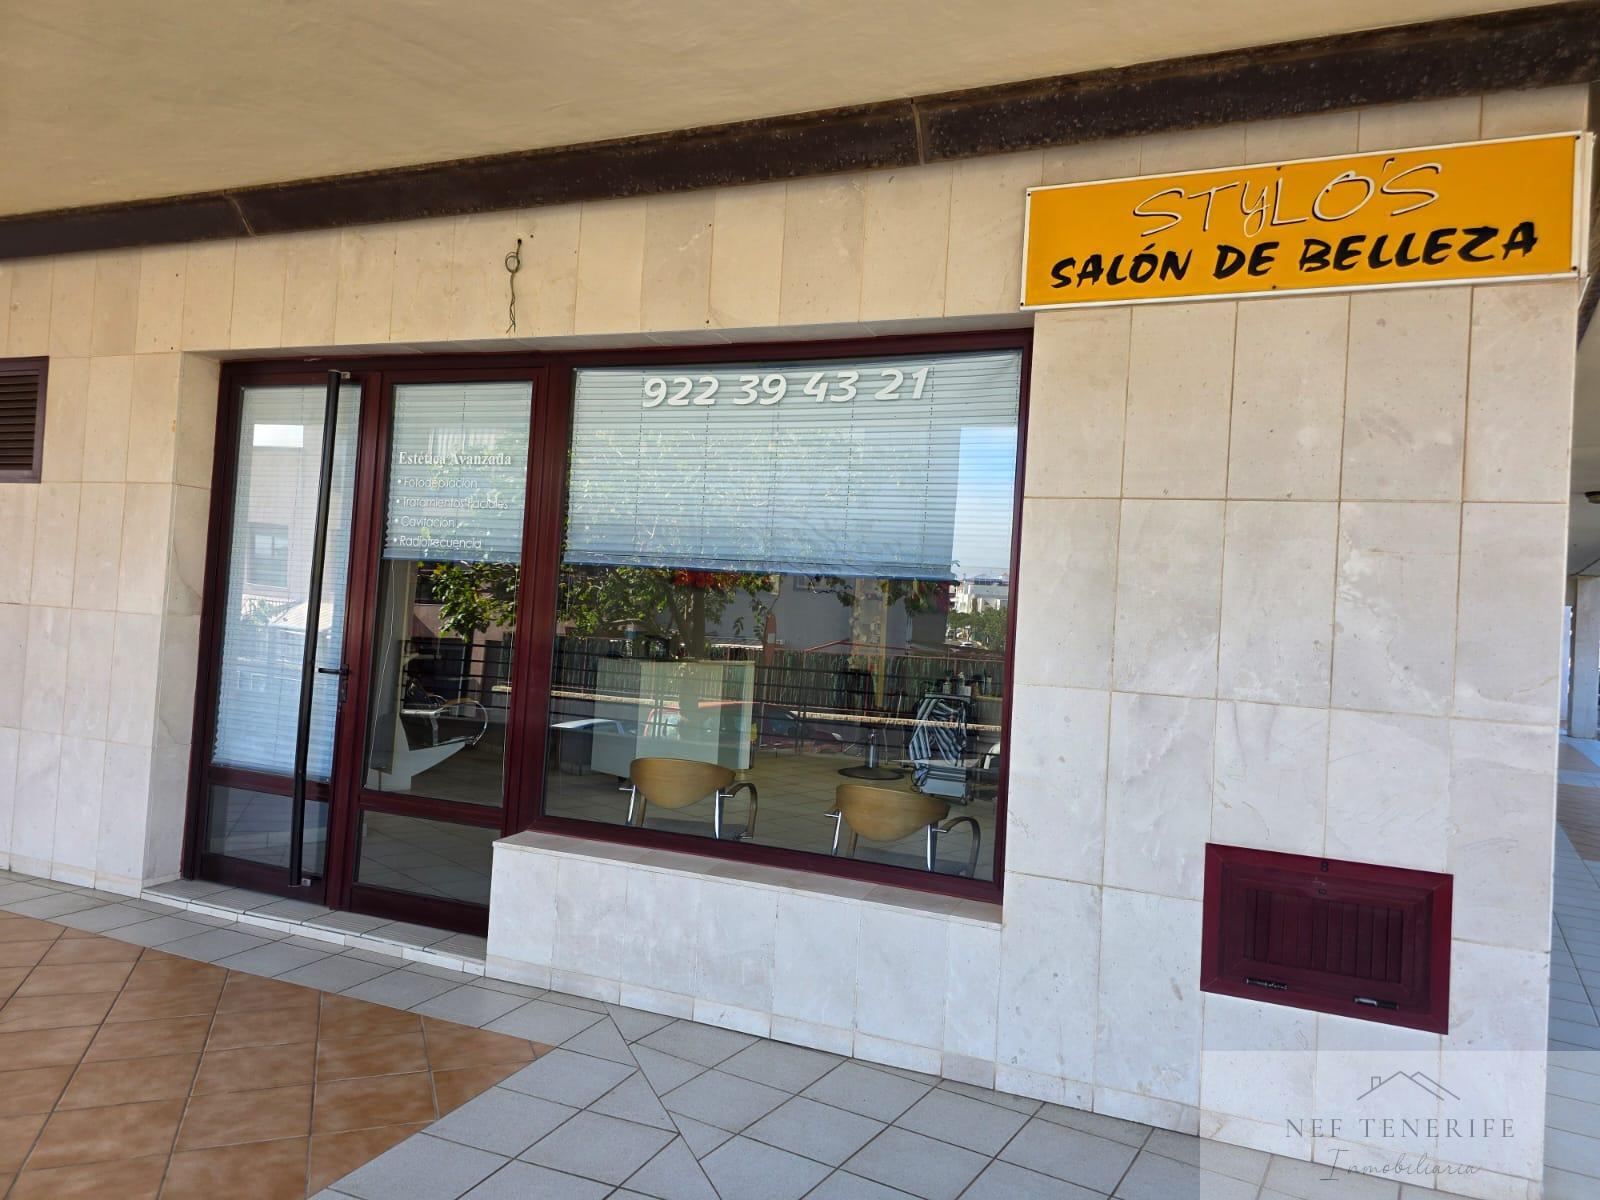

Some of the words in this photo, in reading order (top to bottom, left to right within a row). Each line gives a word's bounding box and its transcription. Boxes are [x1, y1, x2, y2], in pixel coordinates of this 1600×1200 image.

[1050, 243, 1193, 289] SALÓN
[1213, 241, 1280, 280] DE
[1299, 221, 1538, 272] BELLEZA
[642, 376, 719, 408] 922
[733, 373, 788, 406] 39
[803, 370, 860, 402] 43
[874, 367, 930, 400] 21
[398, 451, 446, 465] Estética
[449, 451, 512, 466] Avanzada
[402, 495, 466, 508] Tratamientos
[400, 513, 455, 528] Cavitación
